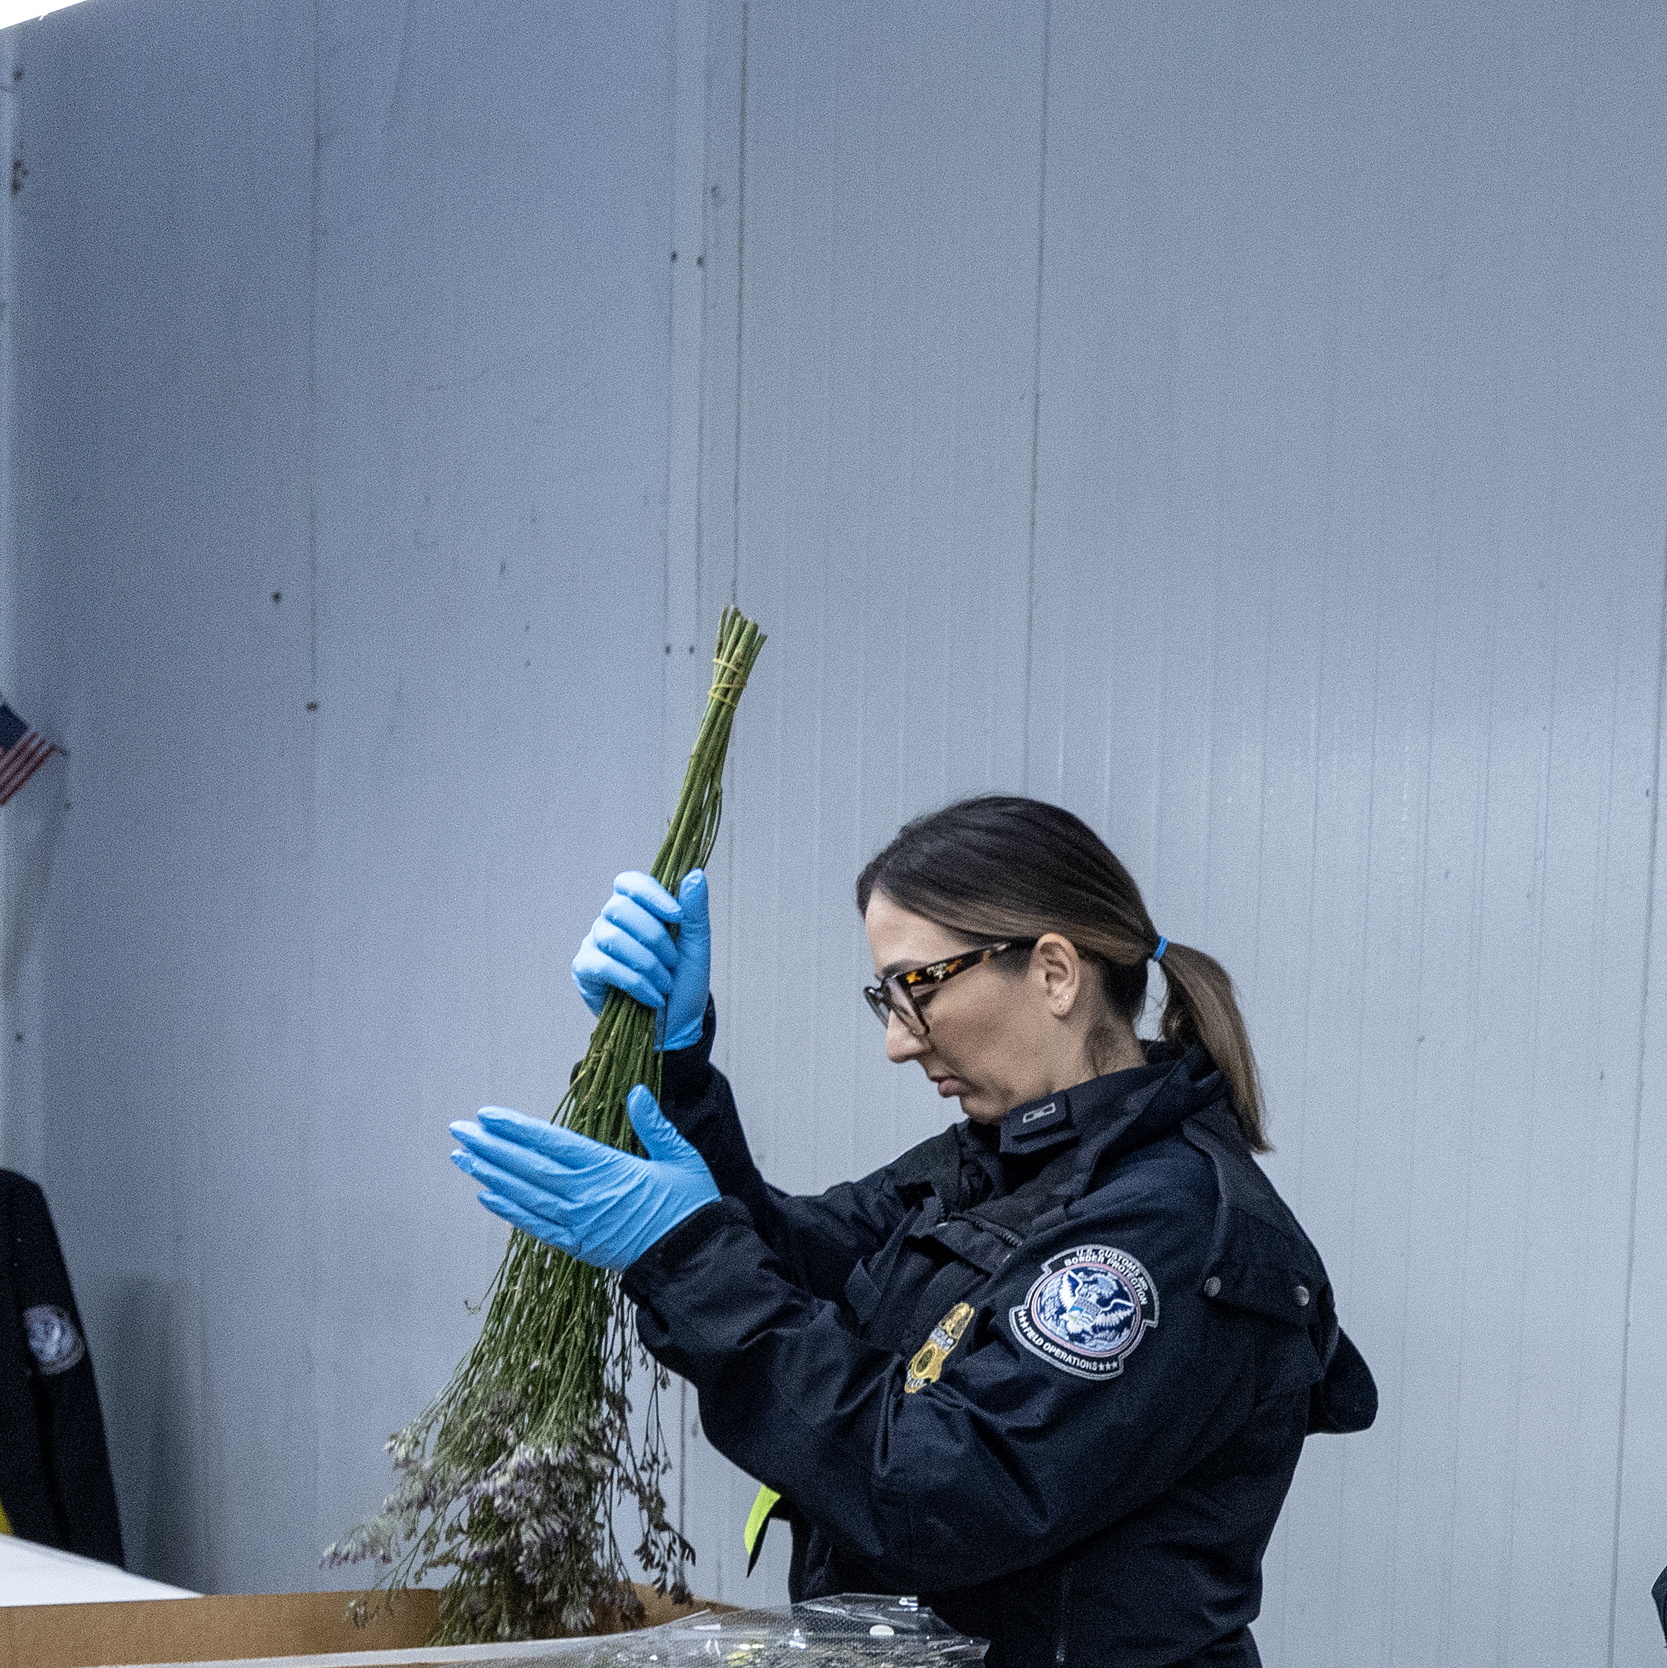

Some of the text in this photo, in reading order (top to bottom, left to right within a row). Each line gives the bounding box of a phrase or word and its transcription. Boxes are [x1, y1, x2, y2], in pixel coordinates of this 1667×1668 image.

[1106, 1258, 1148, 1305] PROTECTION
[1023, 1326, 1097, 1371] FIELD OPERATIONS
